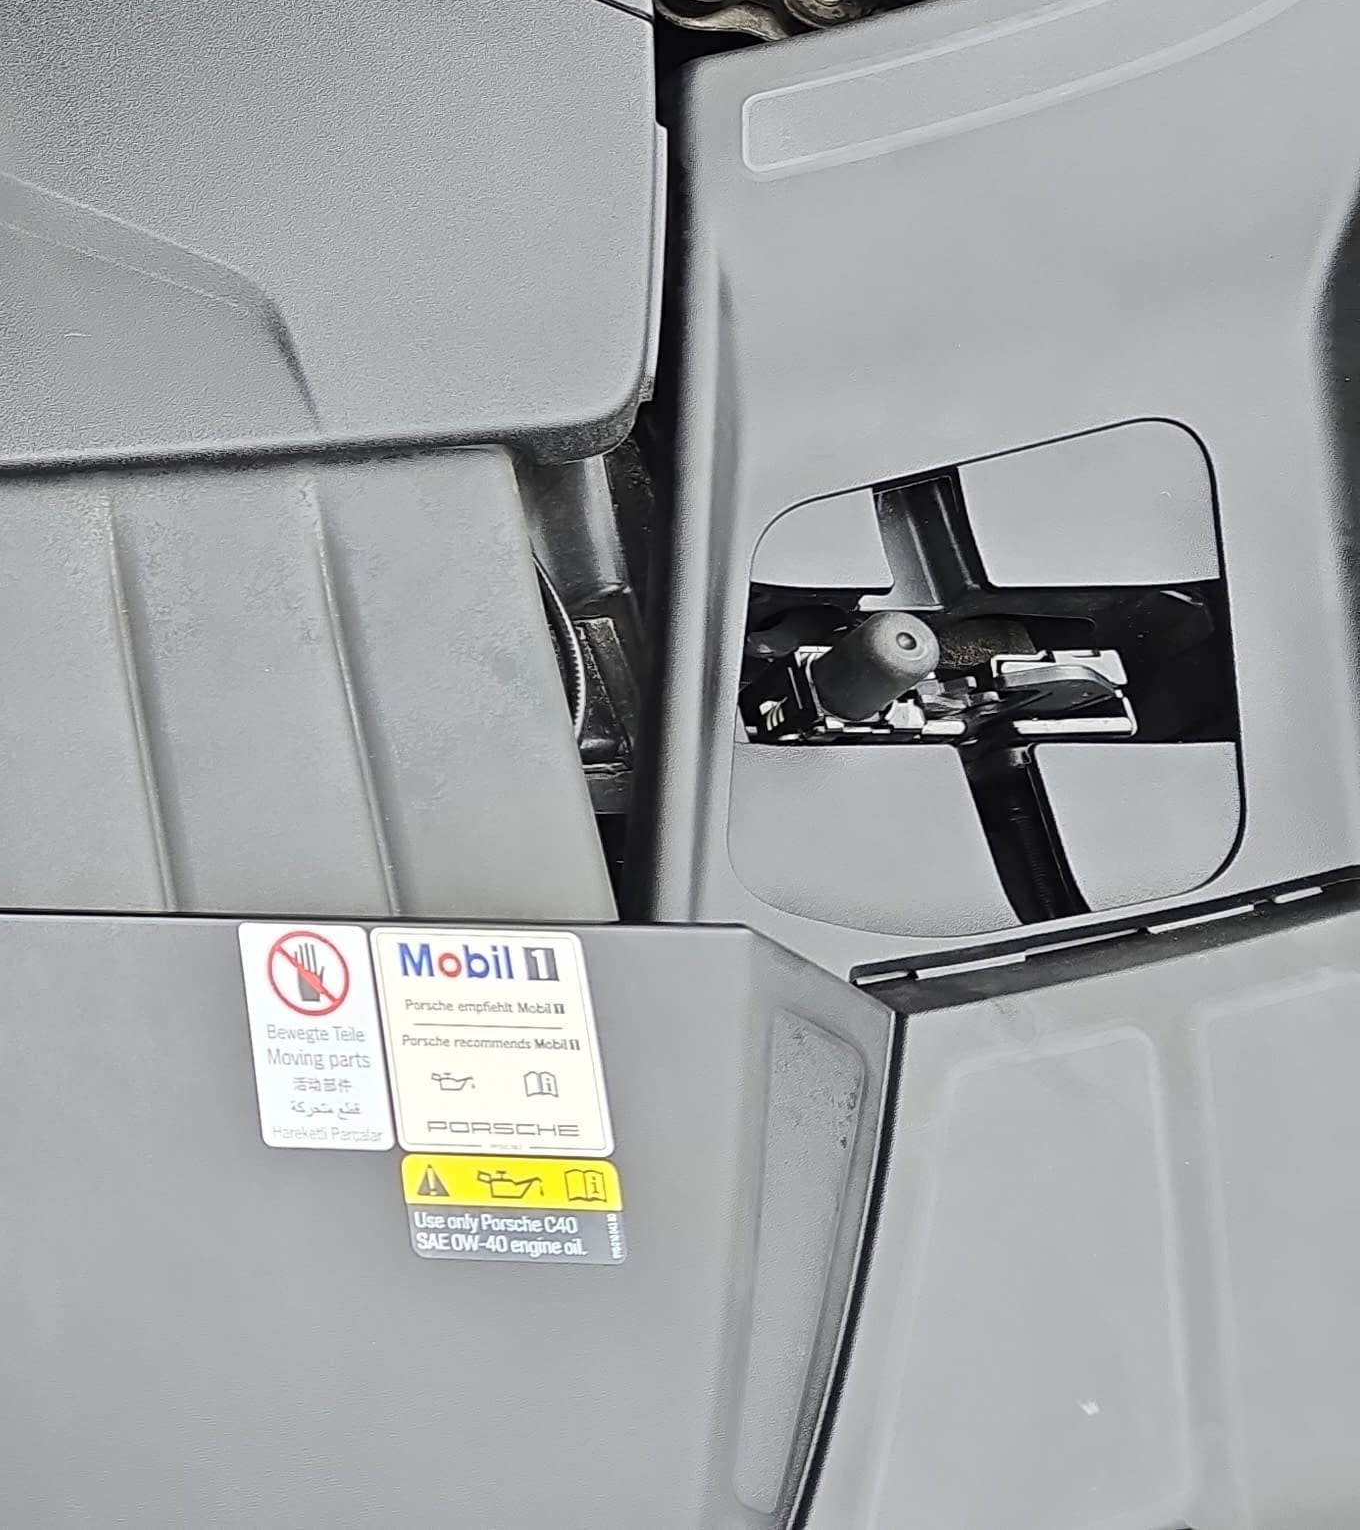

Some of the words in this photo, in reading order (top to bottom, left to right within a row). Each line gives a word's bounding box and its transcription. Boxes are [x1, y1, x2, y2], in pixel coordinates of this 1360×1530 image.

[397, 942, 515, 980] Mobil
[405, 999, 454, 1013] Porsche
[458, 1000, 514, 1016] empfiehlt
[518, 1002, 552, 1015] Mobil
[266, 1023, 329, 1044] Bewegte
[332, 1024, 366, 1043] Teile
[402, 1035, 450, 1048] Porsche
[454, 1037, 532, 1050] recommends
[534, 1038, 568, 1050] Mobil
[267, 1048, 325, 1071] Moving
[329, 1051, 371, 1071] parts
[427, 1121, 581, 1137] PORSCHE
[414, 1211, 445, 1230] Use
[447, 1212, 479, 1234] only
[482, 1213, 544, 1233] Porsche
[544, 1216, 579, 1234] C40
[416, 1232, 450, 1251] SAE
[451, 1234, 508, 1253] 0W-40
[510, 1237, 563, 1258] engine
